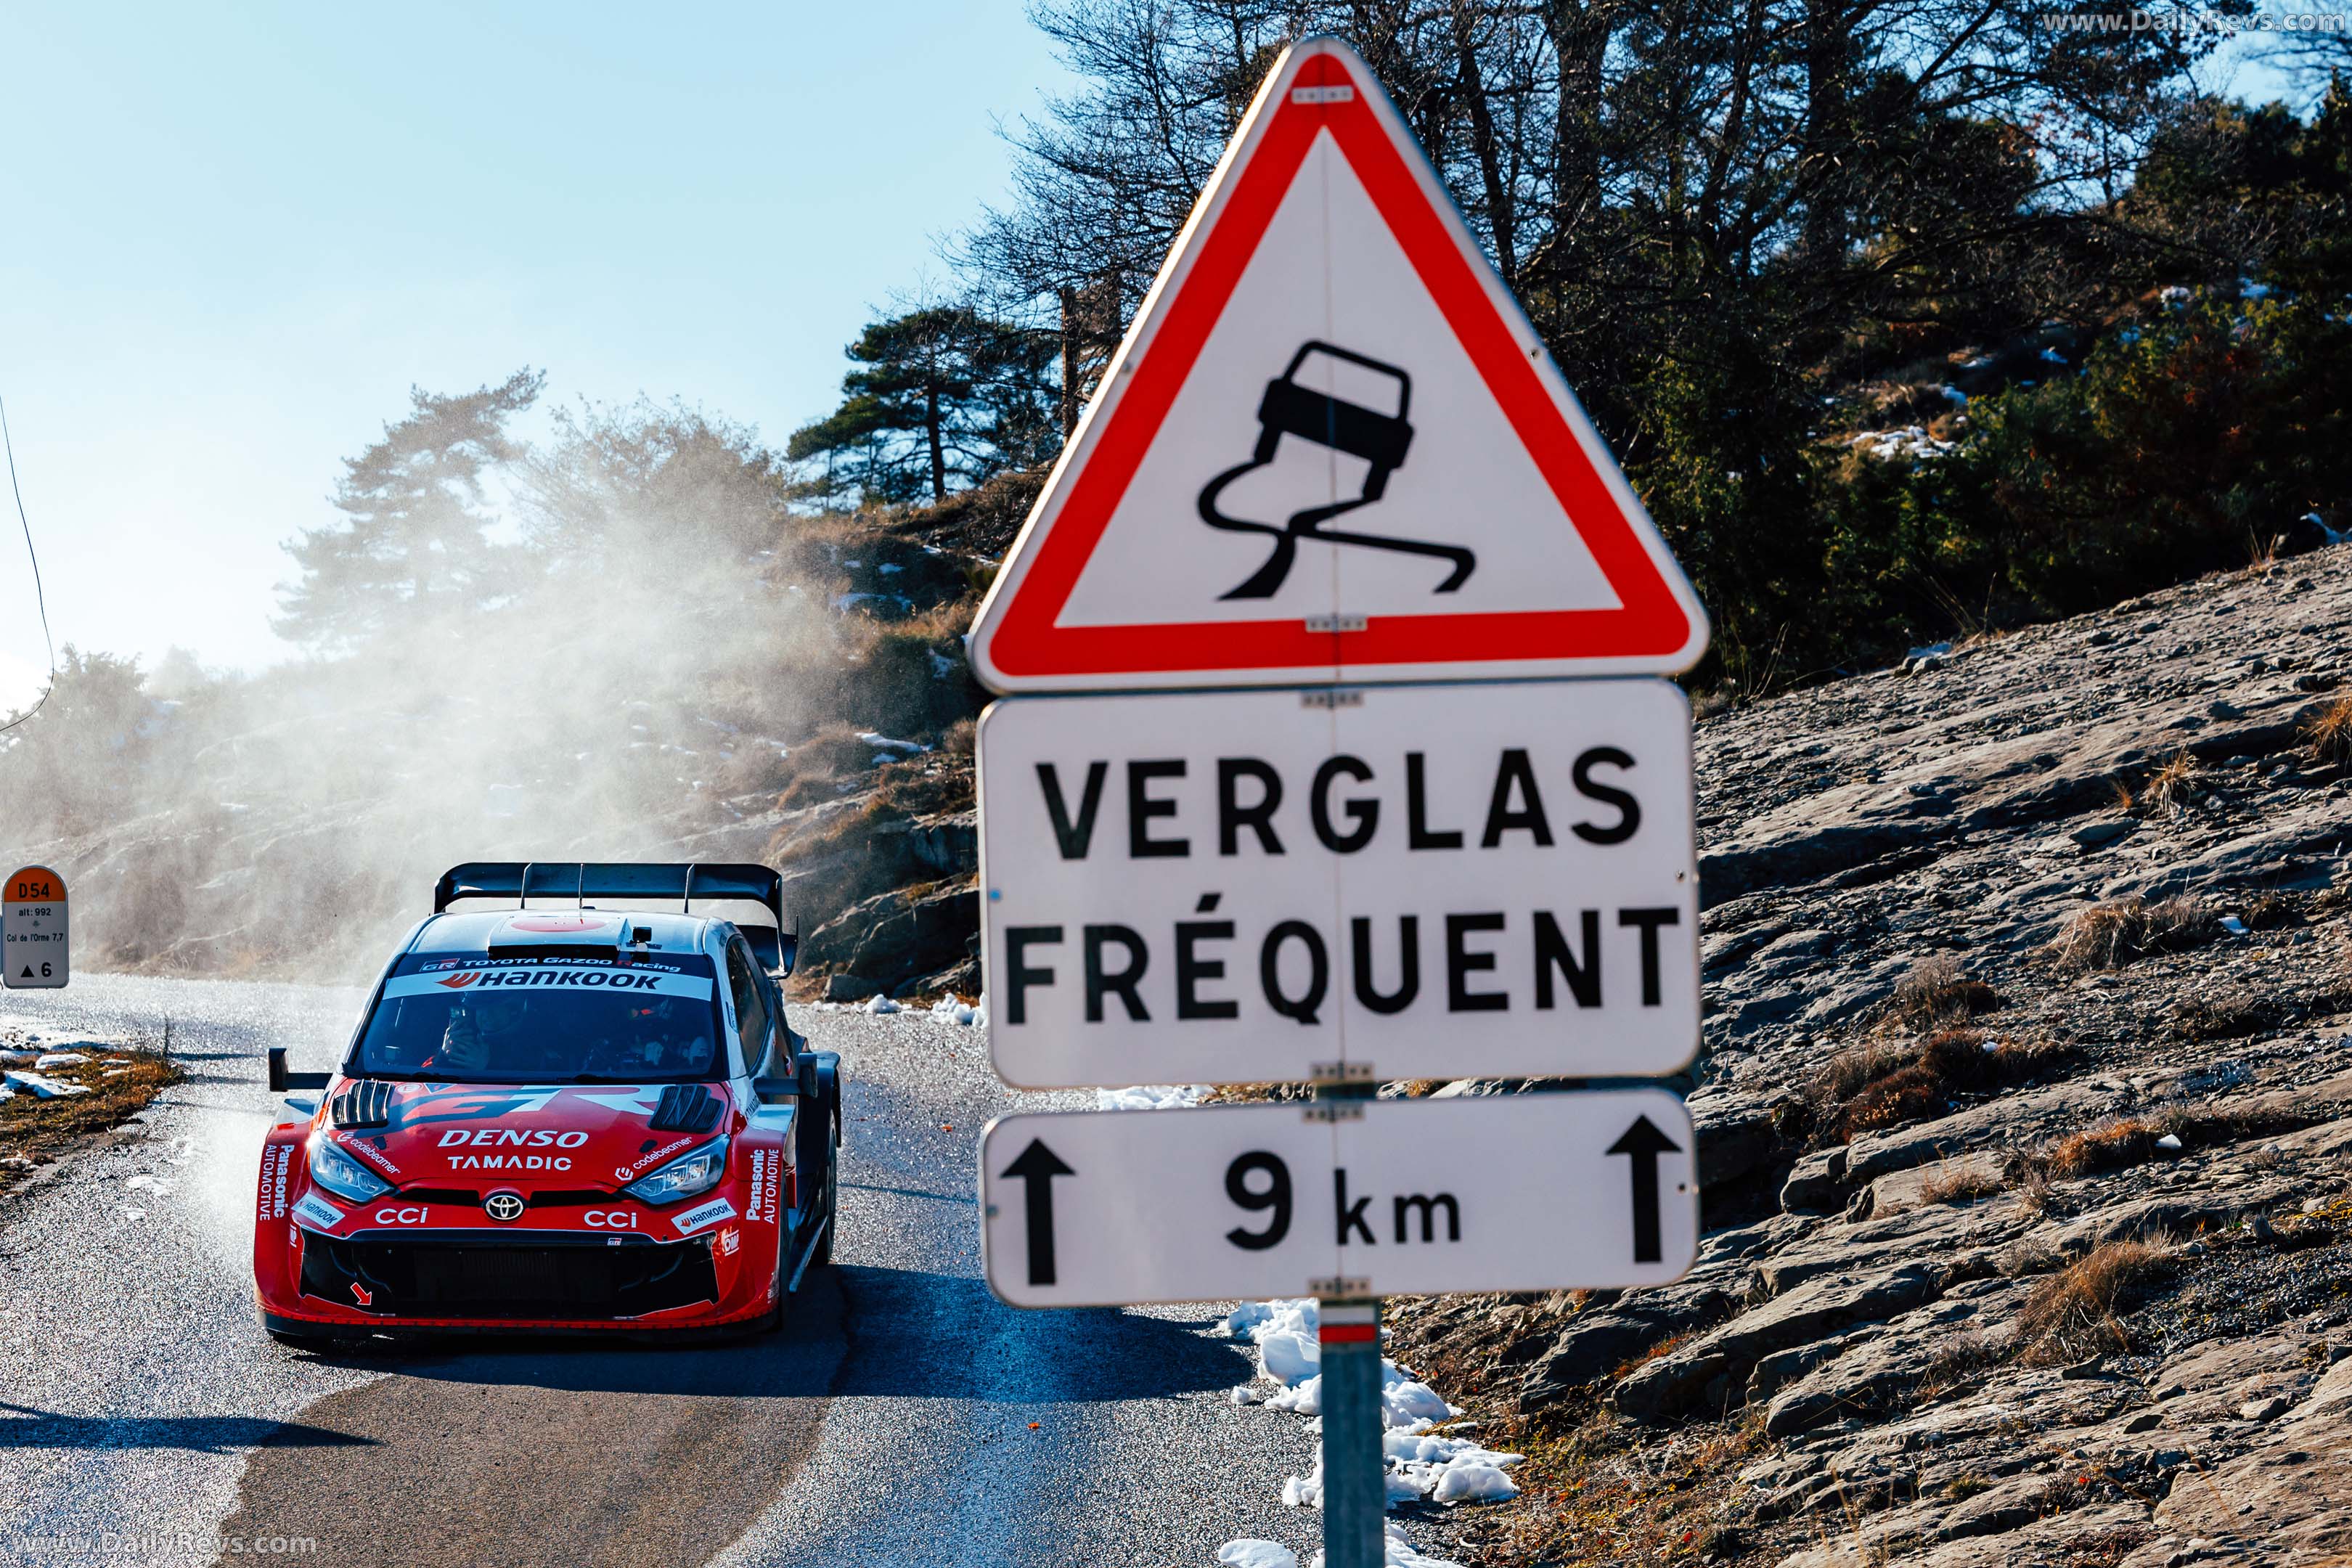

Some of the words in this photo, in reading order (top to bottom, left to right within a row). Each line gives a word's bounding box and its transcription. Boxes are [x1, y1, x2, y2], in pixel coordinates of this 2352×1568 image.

[1034, 746, 1641, 860] VERGLAS
[41, 962, 52, 978] 6
[463, 957, 538, 967] TOYOTA
[617, 959, 681, 973] Racing
[1005, 893, 1680, 1026] FRÉQUENT
[350, 1138, 401, 1175] codebeamer
[437, 1130, 589, 1148] DENSO
[447, 1156, 572, 1171] TAMADIC
[632, 1137, 693, 1170] codebeamer
[260, 1144, 277, 1221] AUTOMOTIVE
[274, 1144, 295, 1218] Panasonic
[746, 1149, 765, 1221] Panasonic
[764, 1148, 779, 1224] AUTOMOTIVE
[1225, 1151, 1293, 1251] 9
[1334, 1167, 1461, 1246] km
